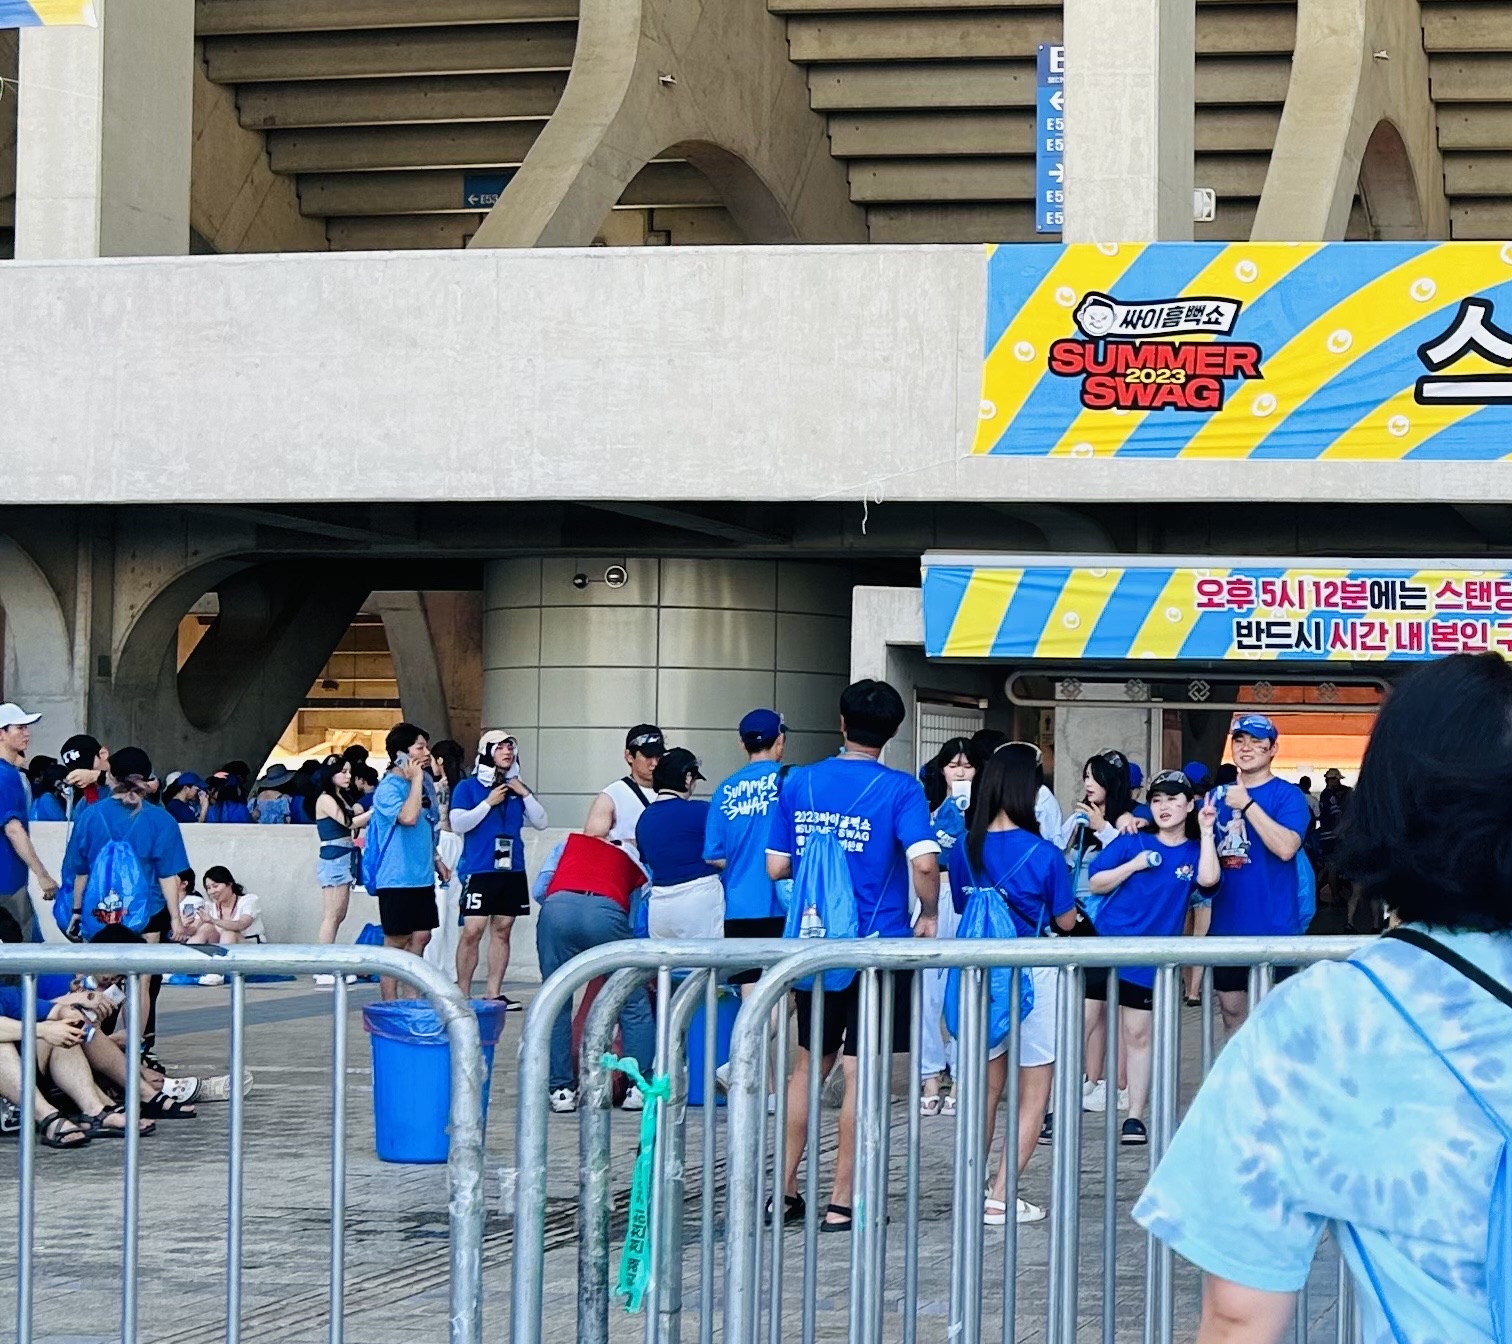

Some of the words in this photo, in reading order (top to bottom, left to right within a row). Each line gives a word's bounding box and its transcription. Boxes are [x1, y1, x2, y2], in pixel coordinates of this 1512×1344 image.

[1046, 118, 1064, 130] E5
[1046, 139, 1064, 151] E5
[1046, 190, 1064, 203] E5
[1046, 212, 1064, 225] E5
[1118, 304, 1226, 331] 싸이흠뻑쇼
[1051, 342, 1260, 376] SUMMER
[1124, 367, 1187, 384] 2023
[1082, 375, 1222, 408] SWAG
[1196, 578, 1255, 610] 오후
[1261, 579, 1305, 610] 5시
[1311, 580, 1428, 611] 12분에는
[1235, 620, 1322, 651] 반드시
[1329, 621, 1390, 652] 시간
[1394, 621, 1423, 652] 내
[1430, 621, 1489, 653] 본인
[466, 892, 482, 910] 15
